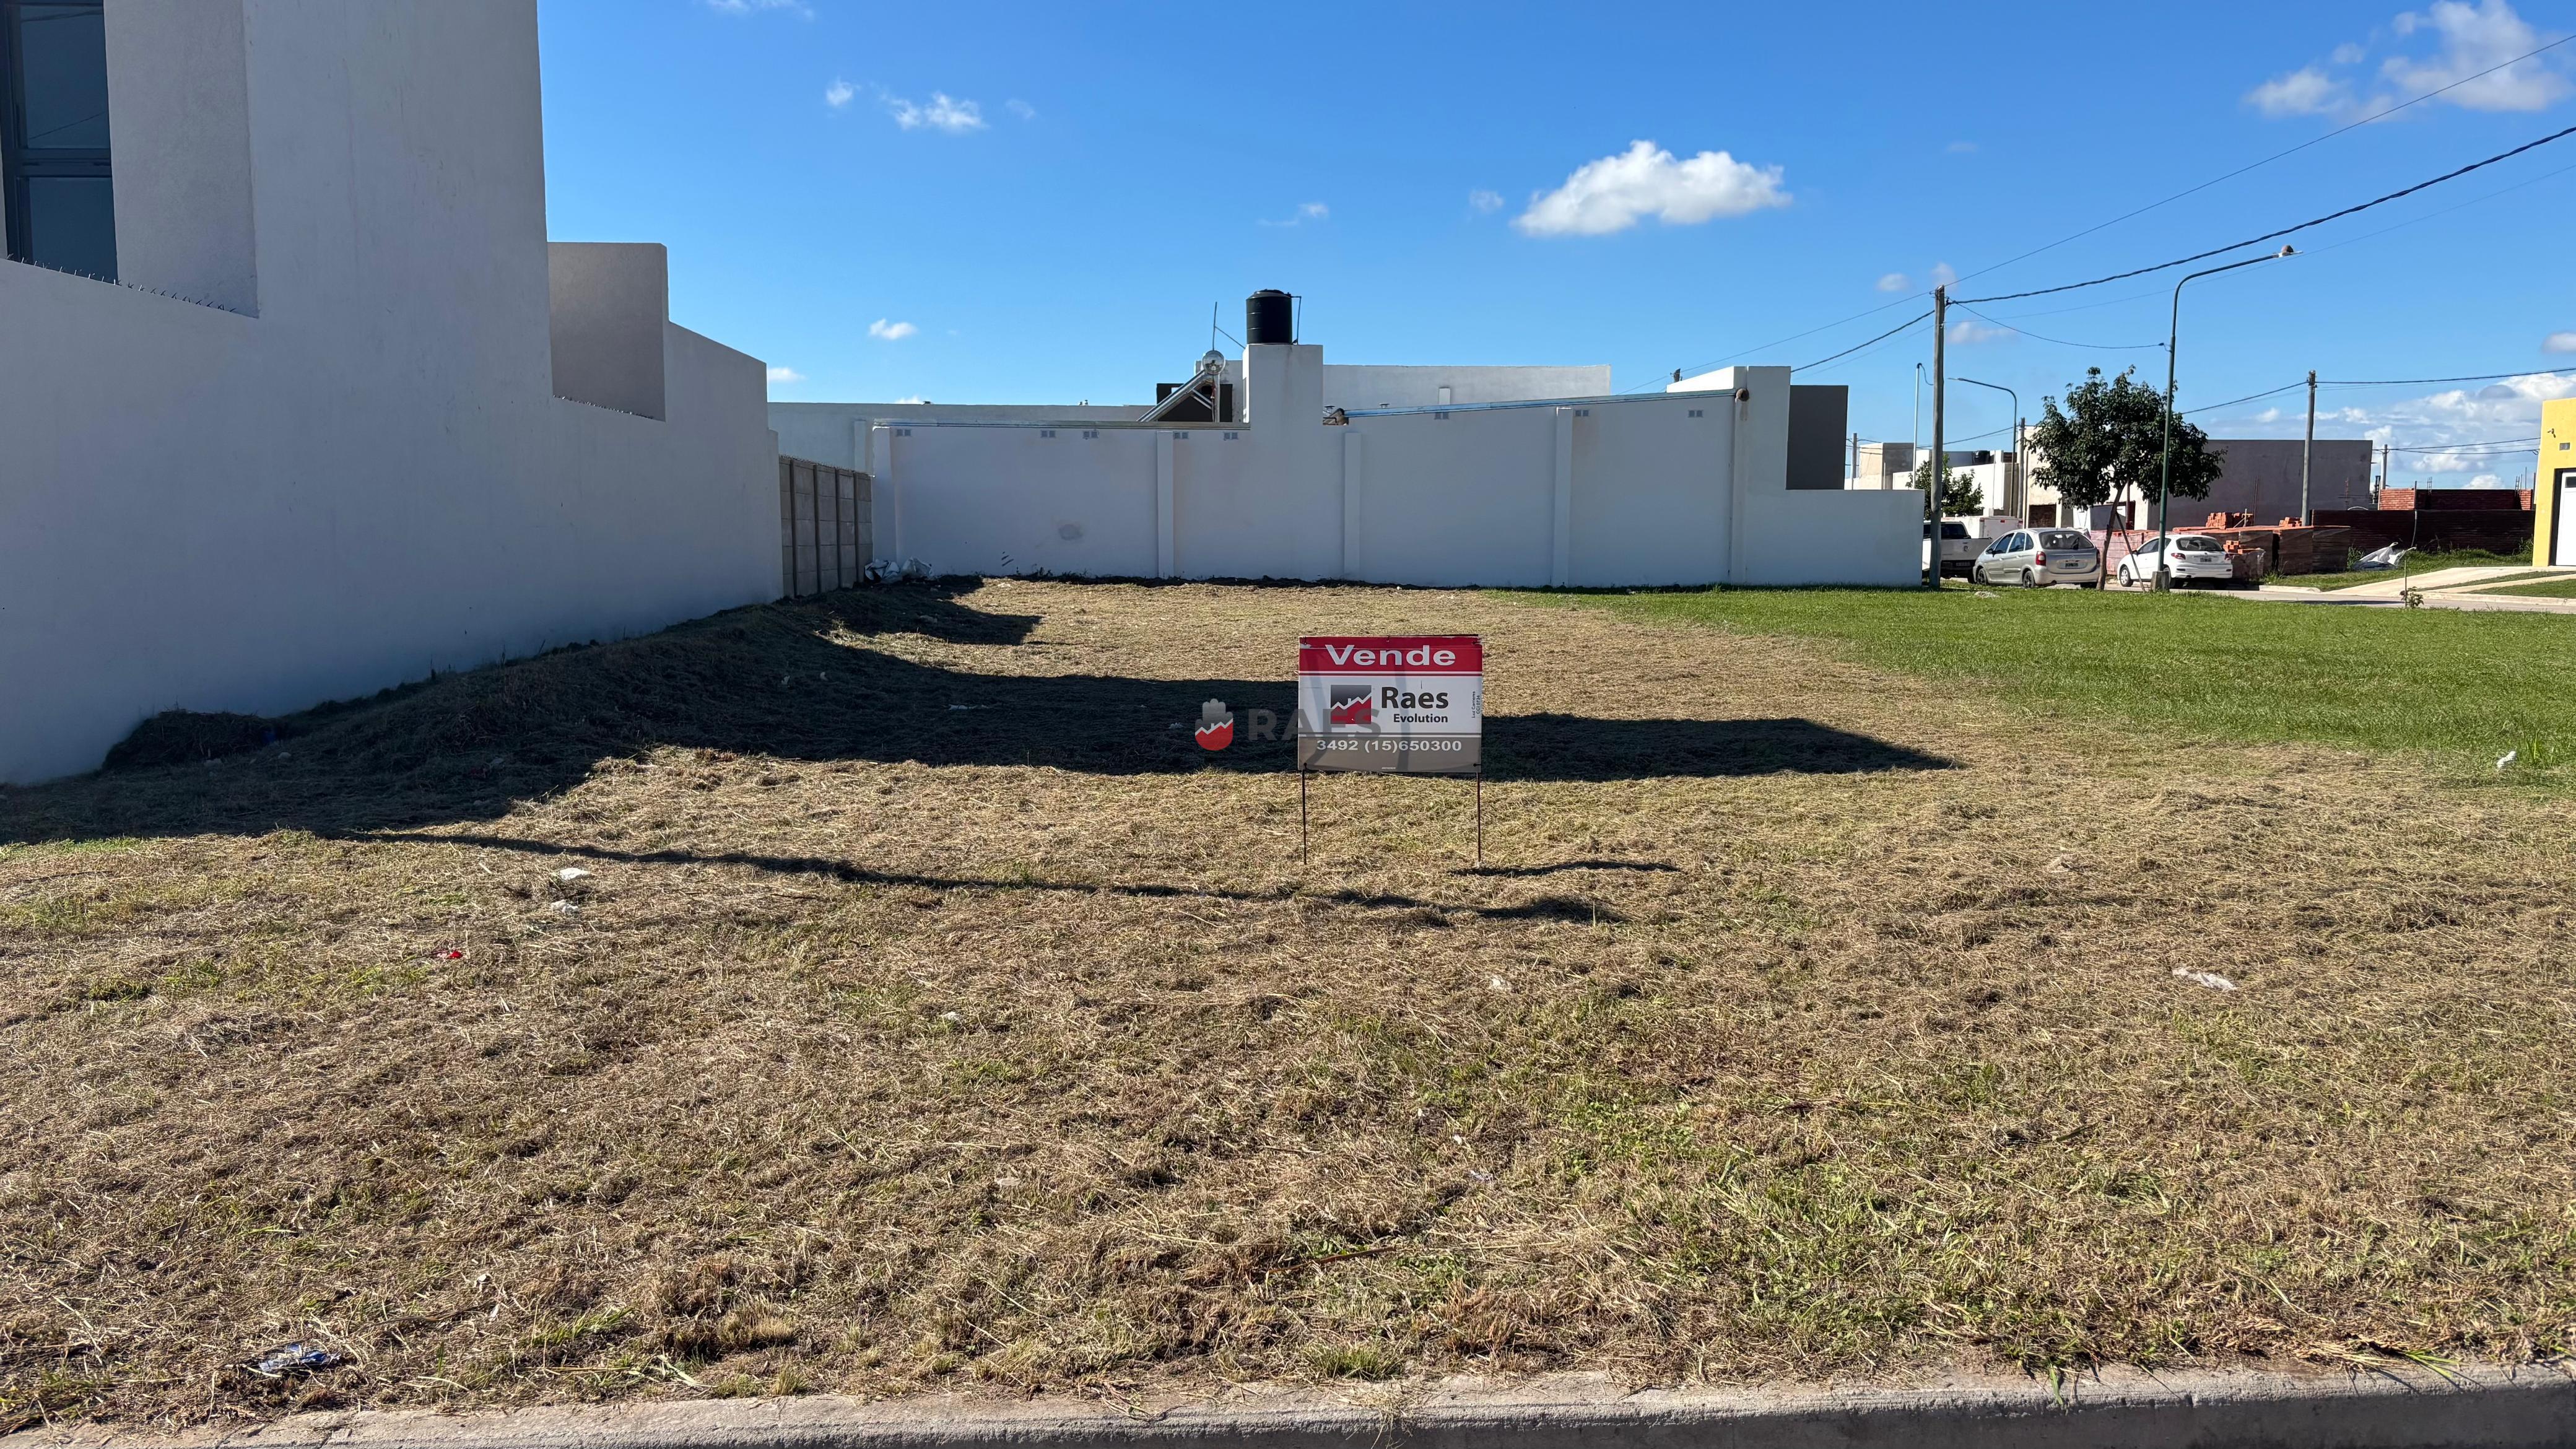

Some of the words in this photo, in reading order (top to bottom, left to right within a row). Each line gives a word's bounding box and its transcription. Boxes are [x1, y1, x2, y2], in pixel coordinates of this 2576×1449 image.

[1325, 645, 1456, 666] Vende
[1382, 687, 1449, 709] Raes
[1393, 713, 1448, 723] Evolution
[1316, 740, 1358, 751] 3492
[1364, 740, 1462, 753] (15)650300
